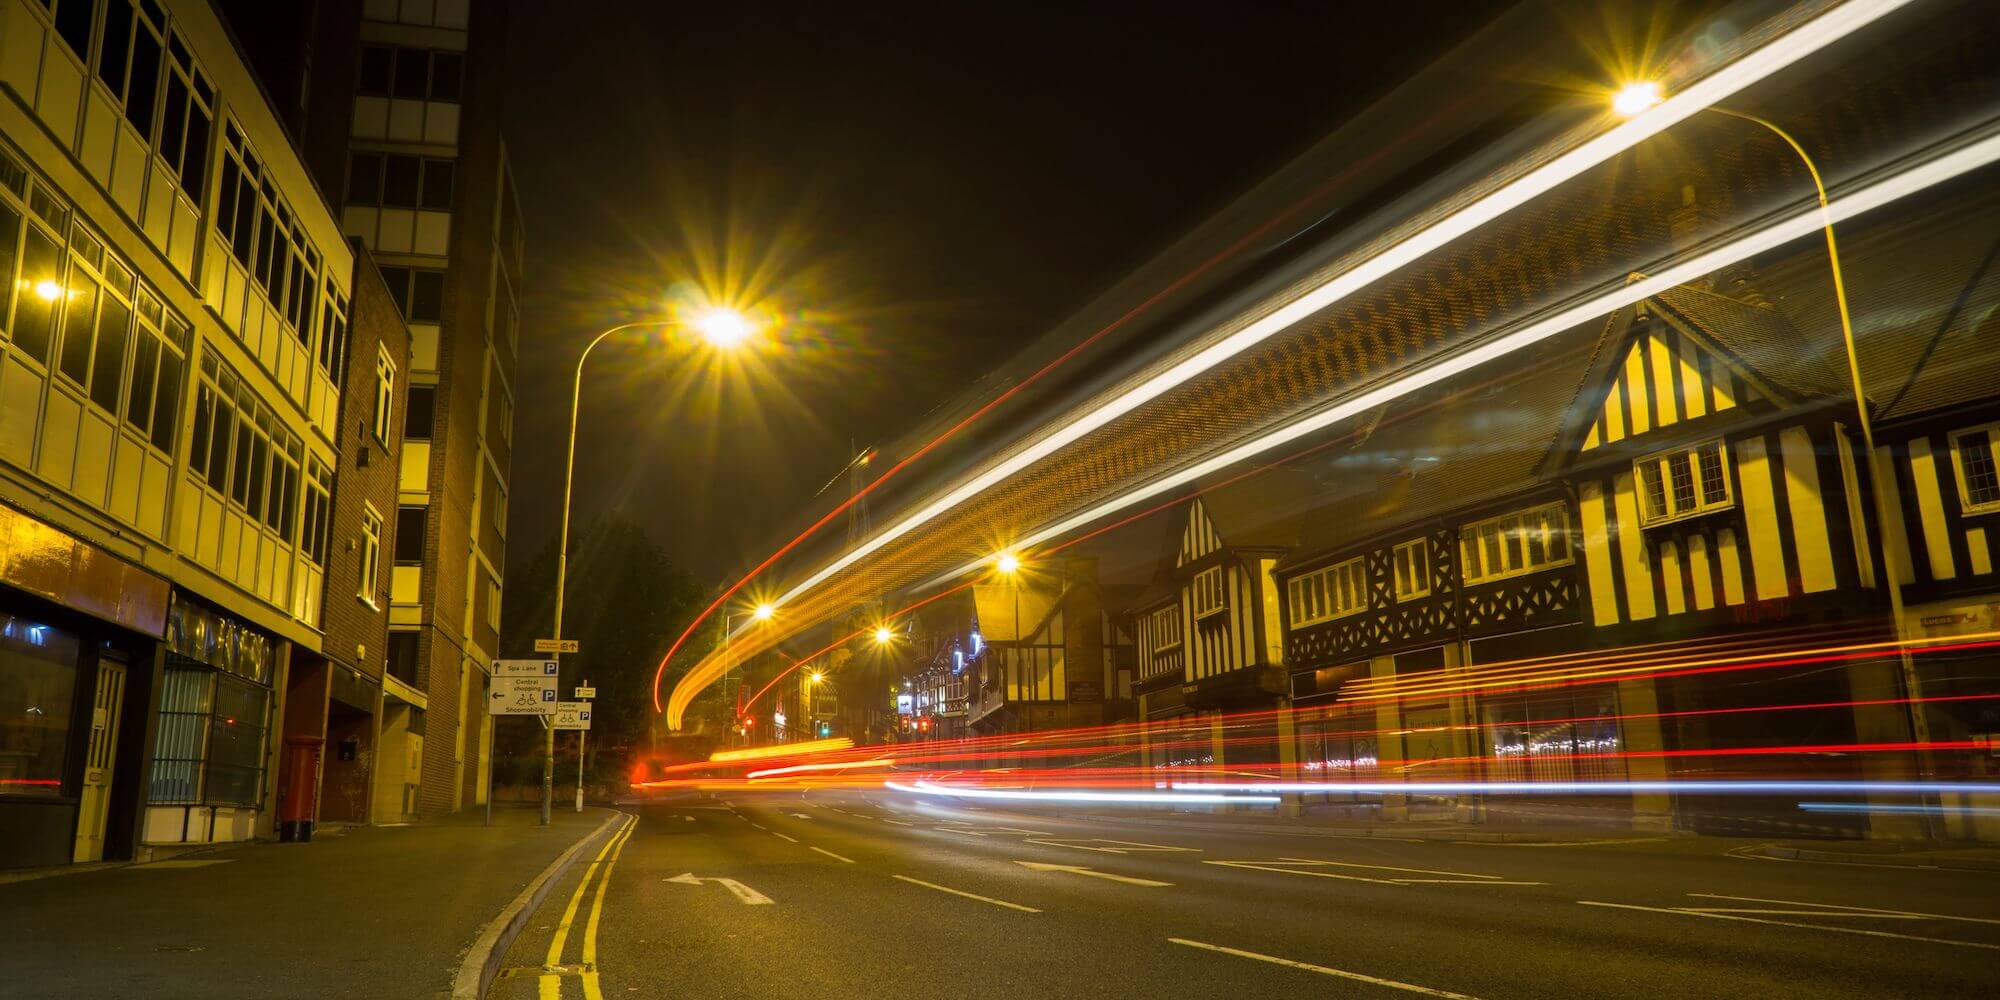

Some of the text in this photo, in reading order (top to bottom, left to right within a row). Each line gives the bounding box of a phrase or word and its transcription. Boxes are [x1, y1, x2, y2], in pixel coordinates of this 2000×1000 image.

[546, 663, 556, 673] P
[545, 690, 554, 701] P
[505, 706, 546, 714] Shopmobility
[581, 712, 589, 720] P
